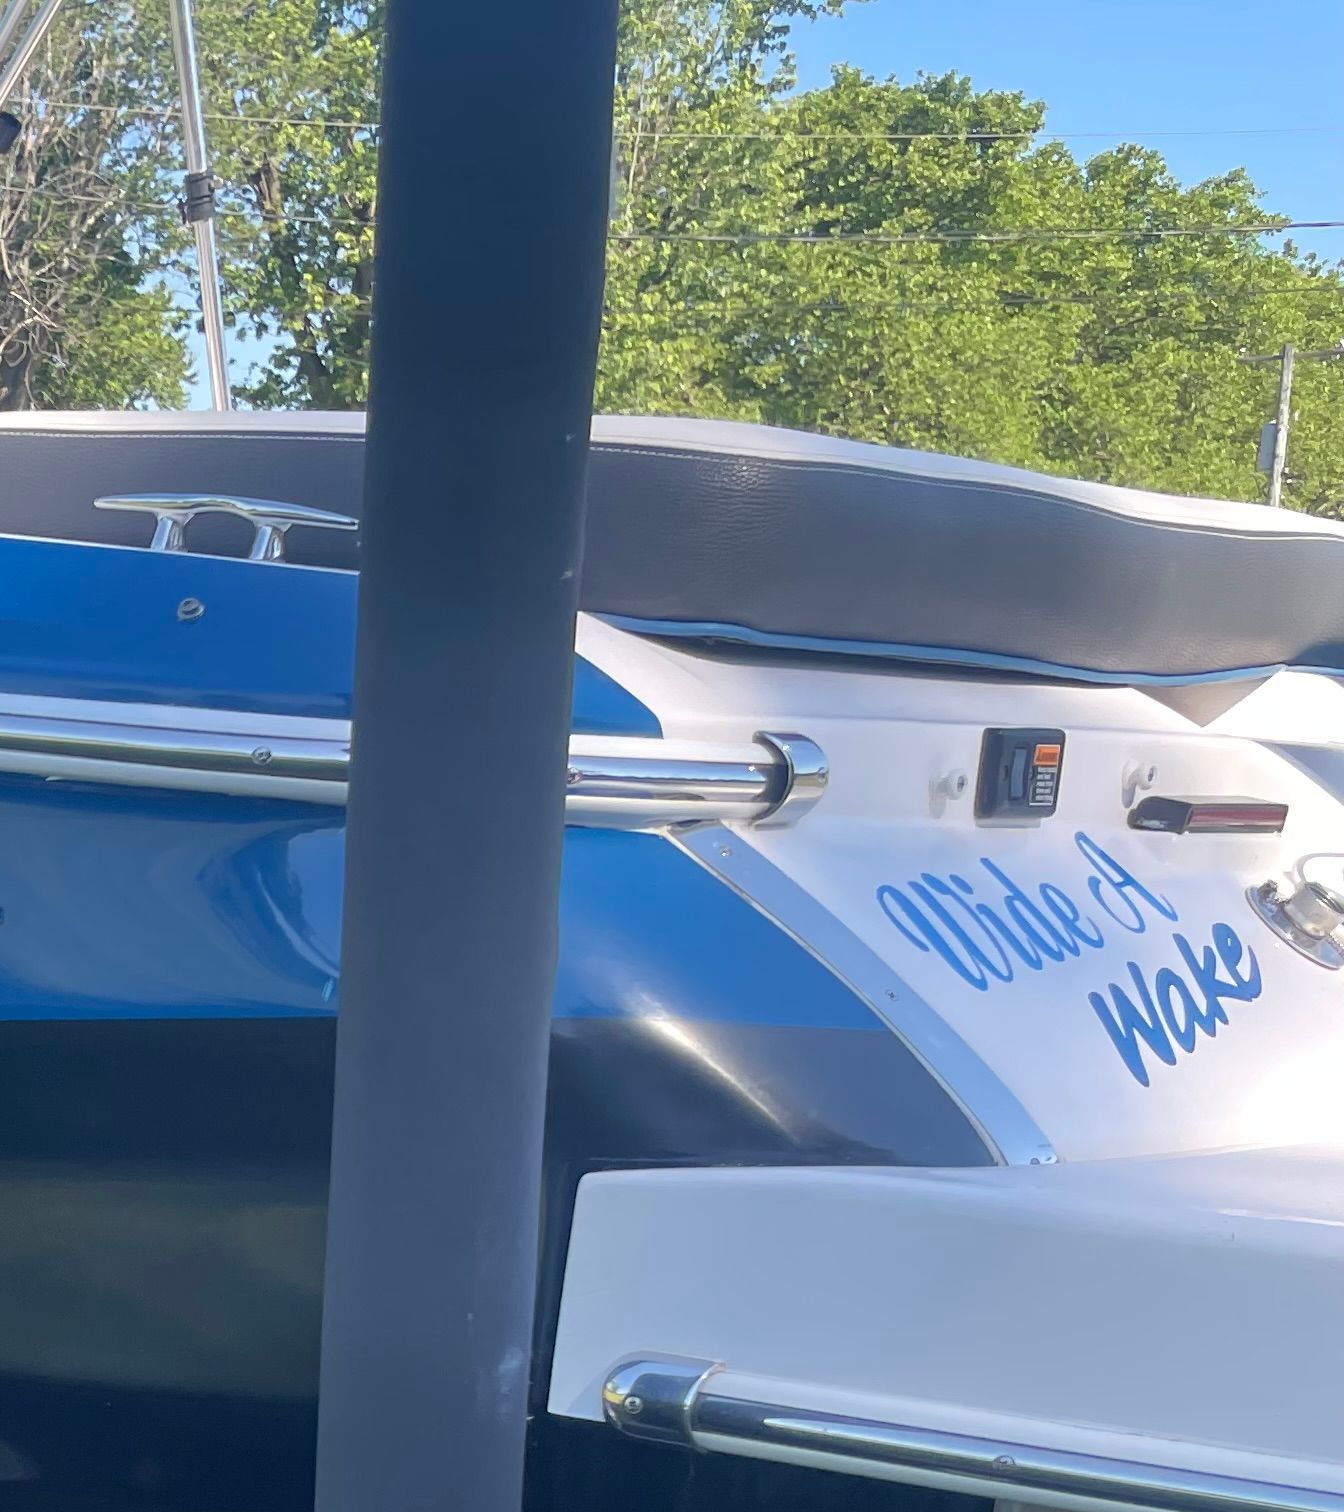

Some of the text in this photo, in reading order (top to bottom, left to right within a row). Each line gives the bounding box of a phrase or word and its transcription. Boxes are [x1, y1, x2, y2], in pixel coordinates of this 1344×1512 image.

[876, 832, 1178, 991] Wide A
[1088, 923, 1262, 1088] Wake
